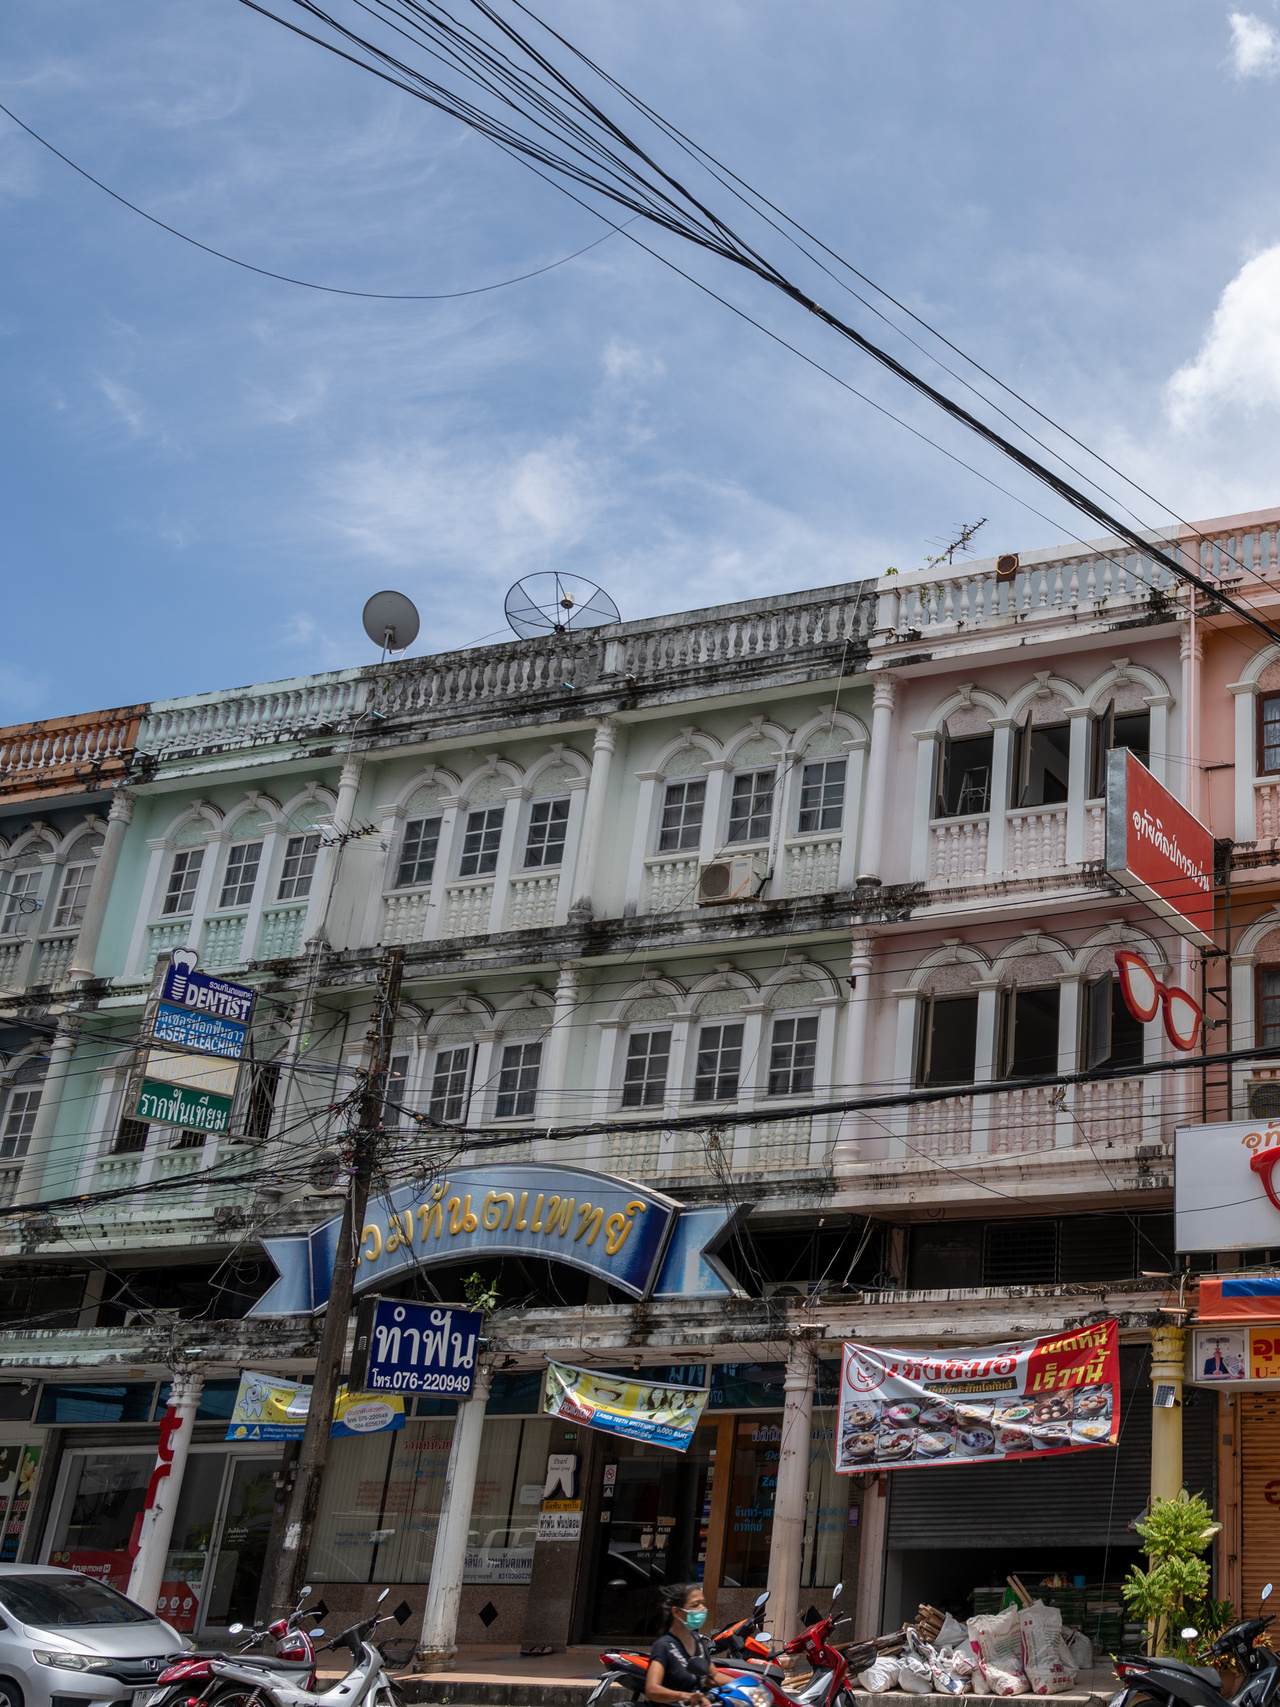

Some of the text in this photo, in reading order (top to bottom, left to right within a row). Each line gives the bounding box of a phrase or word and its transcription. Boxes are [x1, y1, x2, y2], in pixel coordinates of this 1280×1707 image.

[184, 983, 250, 1020] DENTIST
[153, 1021, 242, 1058] LASER BLEACHING
[141, 1088, 227, 1131] รากฟันเทียม
[356, 1180, 648, 1268] วมทันตแพทย์
[374, 1306, 475, 1370] ทำฟัน
[560, 1400, 592, 1420] PROMOTION
[595, 1411, 613, 1422] LASER
[612, 1416, 629, 1425] TEETH
[628, 1419, 656, 1432] WHITENING
[672, 1430, 688, 1440] BAHT
